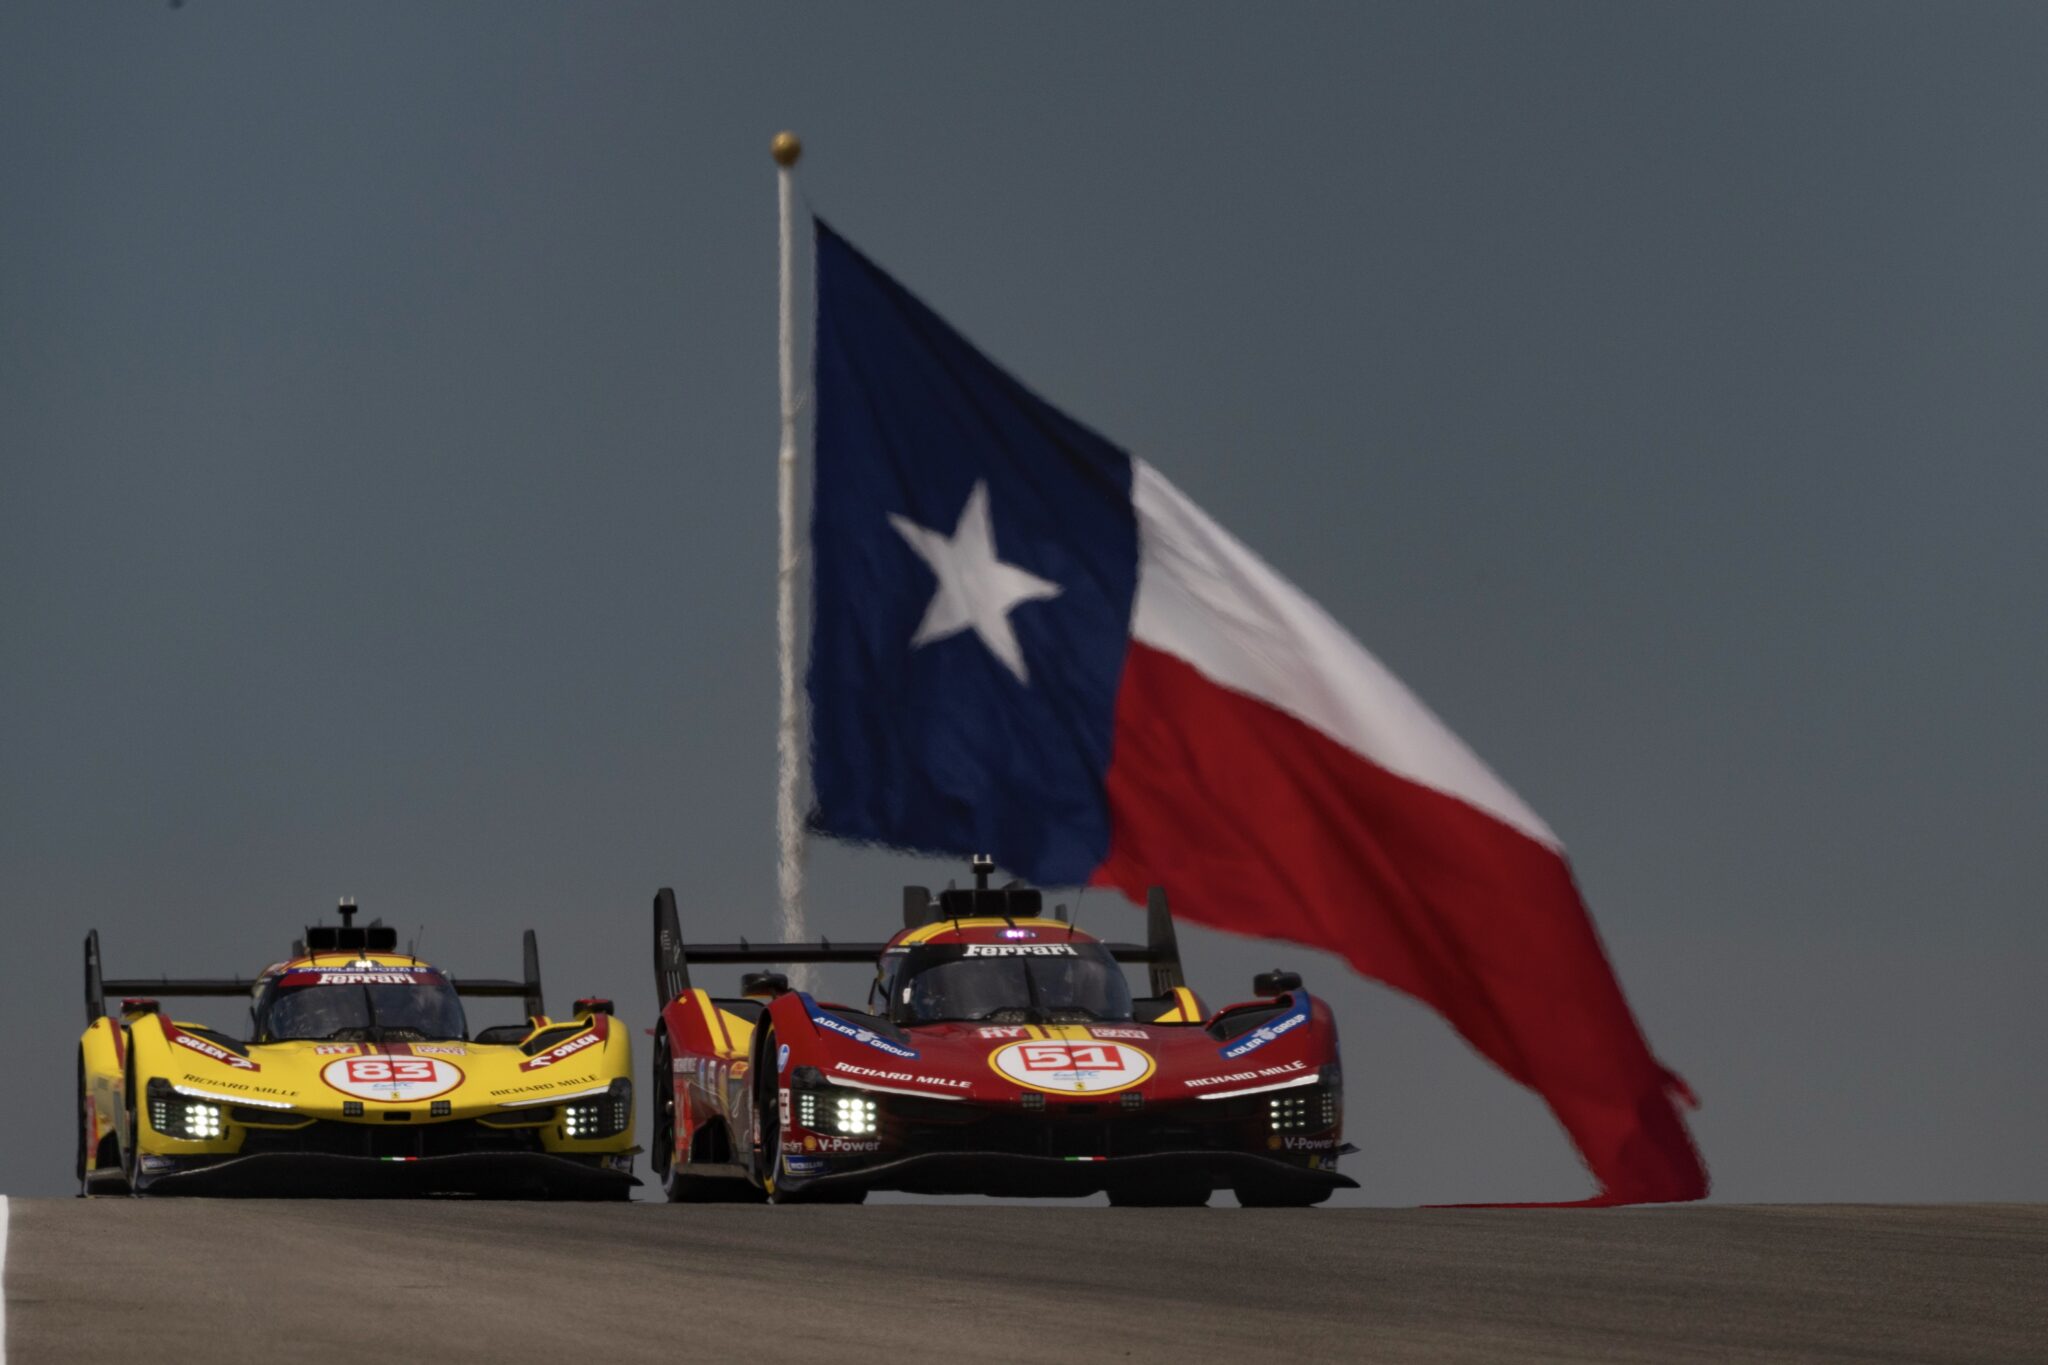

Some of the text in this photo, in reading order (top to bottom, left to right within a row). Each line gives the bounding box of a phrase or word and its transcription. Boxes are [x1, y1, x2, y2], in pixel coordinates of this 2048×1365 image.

[963, 944, 1078, 957] Ferrari
[317, 974, 417, 984] Ferrari
[552, 1034, 599, 1057] ORLEN
[813, 1017, 915, 1058] ADLER GROUP
[1226, 1014, 1306, 1058] ADLER GROUP
[176, 1036, 228, 1060] ORLEN
[1024, 1048, 1120, 1068] 51
[352, 1062, 432, 1080] 83
[835, 1062, 973, 1088] RICHARD MILLE
[1184, 1060, 1307, 1087] RICHARD MILLE
[183, 1074, 299, 1096] RICHARD MILLE
[490, 1074, 599, 1096] RICHARD MILLE
[818, 1139, 879, 1151] V-Power
[1284, 1137, 1334, 1149] V-Power
